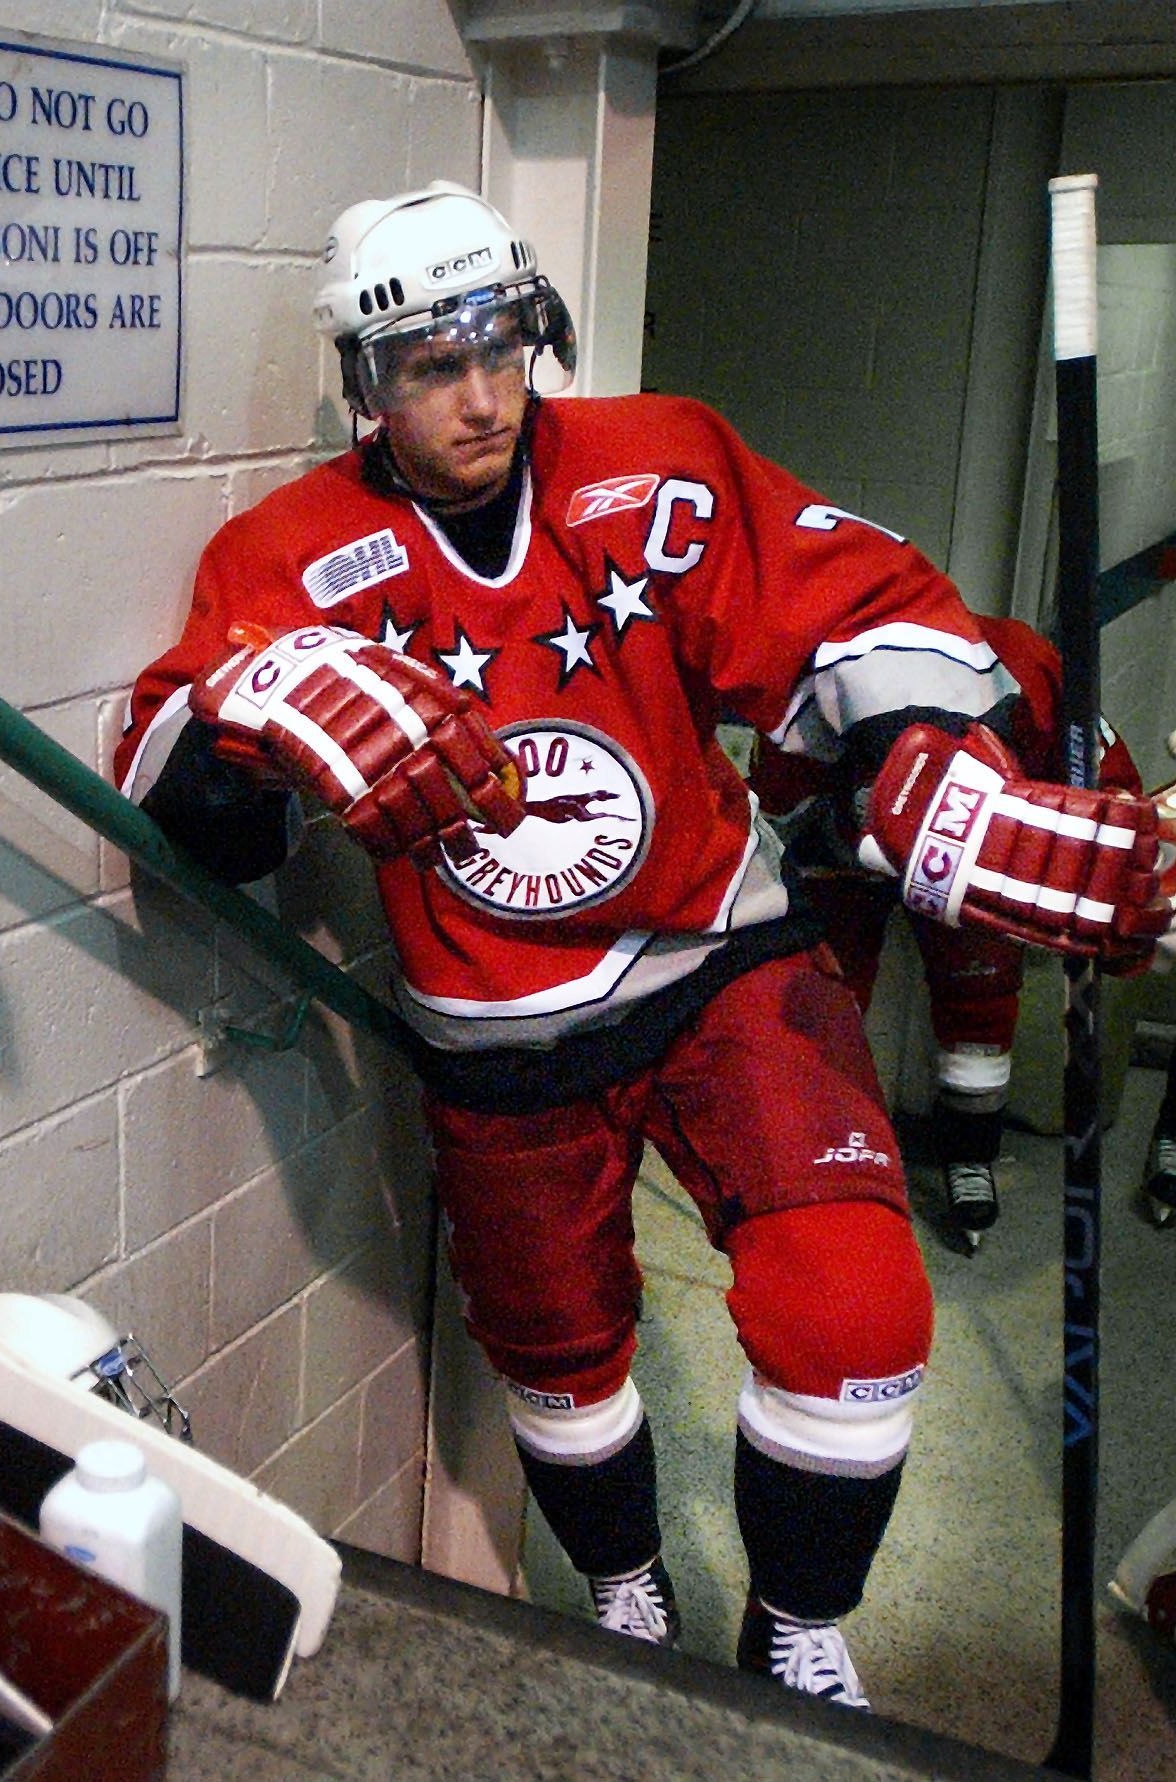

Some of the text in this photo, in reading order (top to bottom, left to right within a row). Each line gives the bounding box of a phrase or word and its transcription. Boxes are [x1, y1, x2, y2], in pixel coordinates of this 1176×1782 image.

[30, 87, 96, 131] NOT
[106, 98, 149, 138] GO
[54, 159, 141, 202] UNTIL
[74, 227, 98, 265] IS
[109, 231, 159, 267] OFF
[427, 247, 492, 280] CCM
[109, 295, 162, 329] ARE
[643, 477, 715, 575] C
[518, 737, 569, 777] OO
[455, 834, 633, 906] GREYHOUNDS
